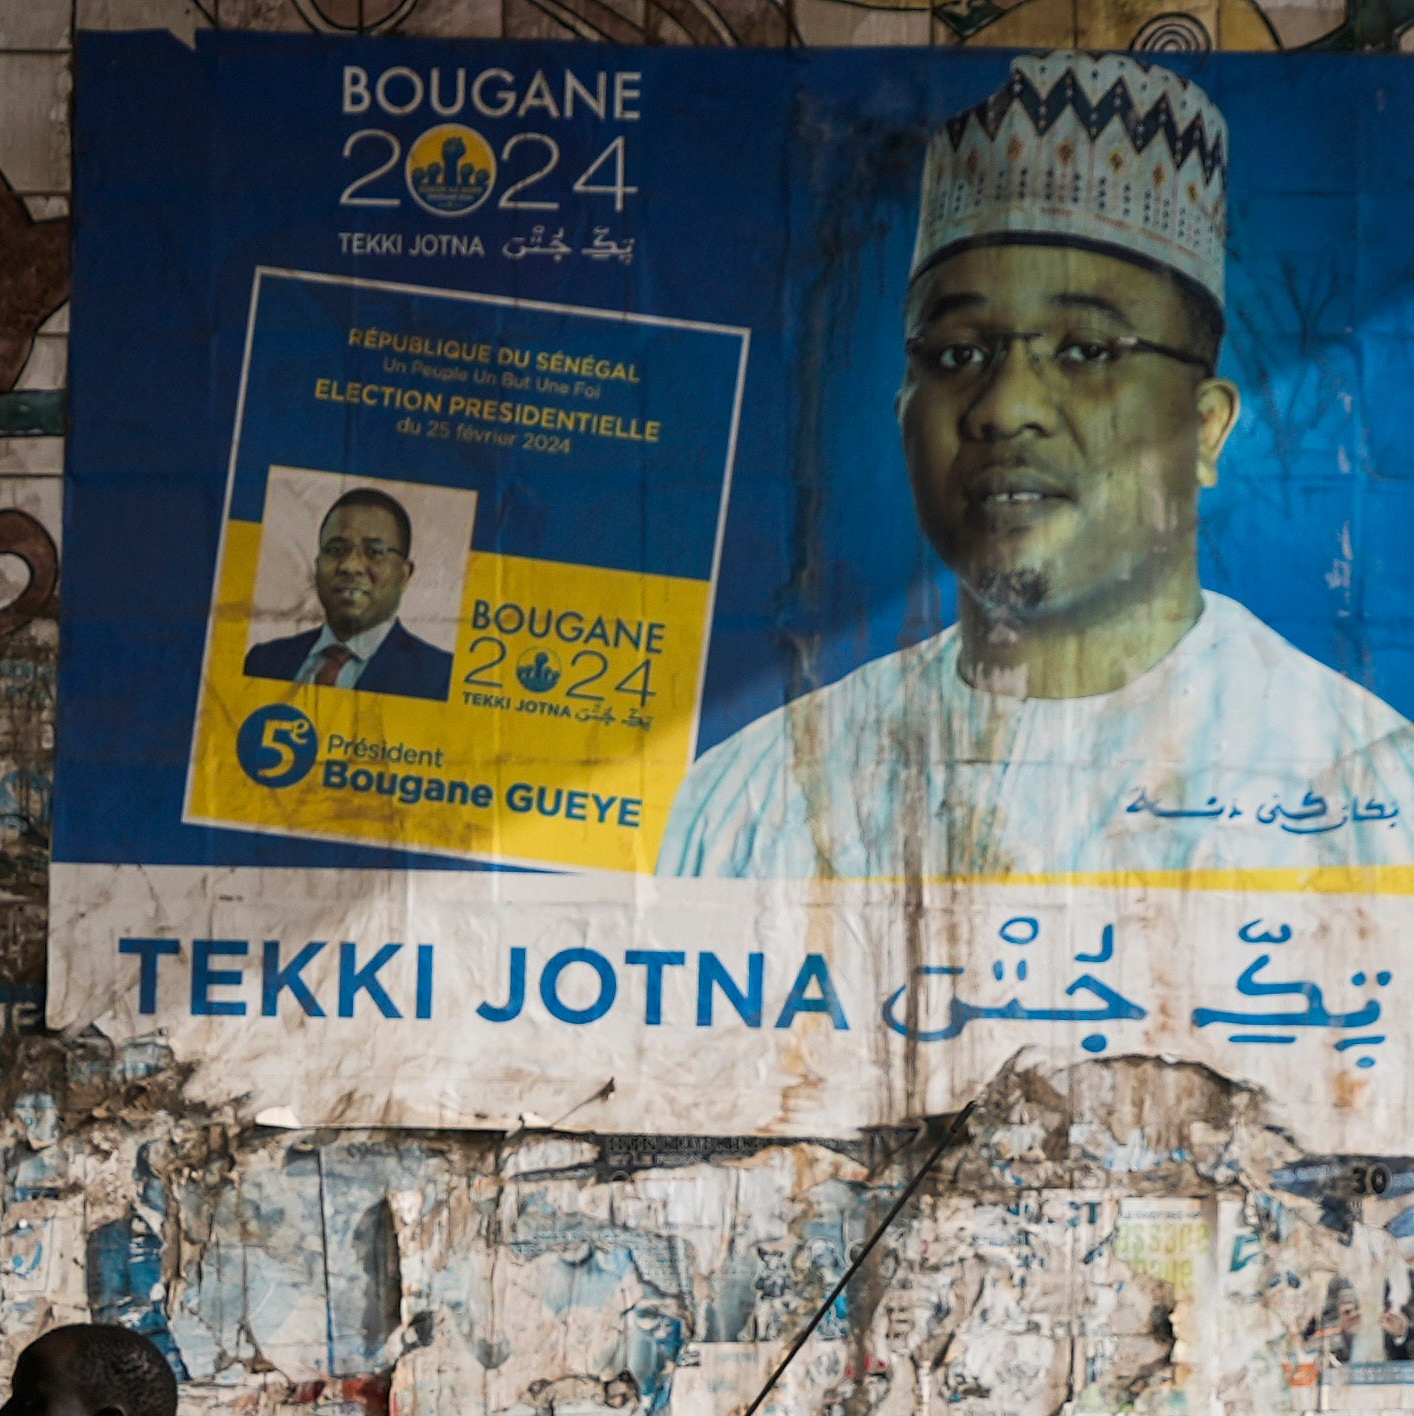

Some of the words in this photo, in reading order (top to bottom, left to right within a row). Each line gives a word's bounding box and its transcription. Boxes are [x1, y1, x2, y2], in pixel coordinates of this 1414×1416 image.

[342, 65, 642, 120] BOUGANE
[339, 232, 402, 255] TEKKI
[408, 233, 485, 257] JOTNA
[348, 328, 491, 362] RÉPUBLIQUE
[497, 347, 530, 367] DU
[536, 351, 641, 383] SÉNÉGAL
[383, 356, 407, 373] Un
[410, 359, 469, 382] Peuple
[473, 368, 497, 384] Un
[501, 371, 532, 391] But
[535, 376, 570, 395] Une
[314, 379, 442, 412] ELECTION
[448, 395, 662, 442] PRESIDENTIELLE
[396, 416, 422, 435] du
[427, 420, 451, 439] 25
[522, 431, 572, 454] 2024
[471, 599, 667, 655] BOUGANE
[463, 691, 511, 710] TEKKI
[515, 697, 572, 718] JOTNA
[328, 733, 444, 768] Président
[322, 759, 493, 807] Bougane
[505, 782, 642, 828] GUEYE
[118, 936, 435, 1019] TEKKI
[475, 945, 850, 1031] JOTNA
